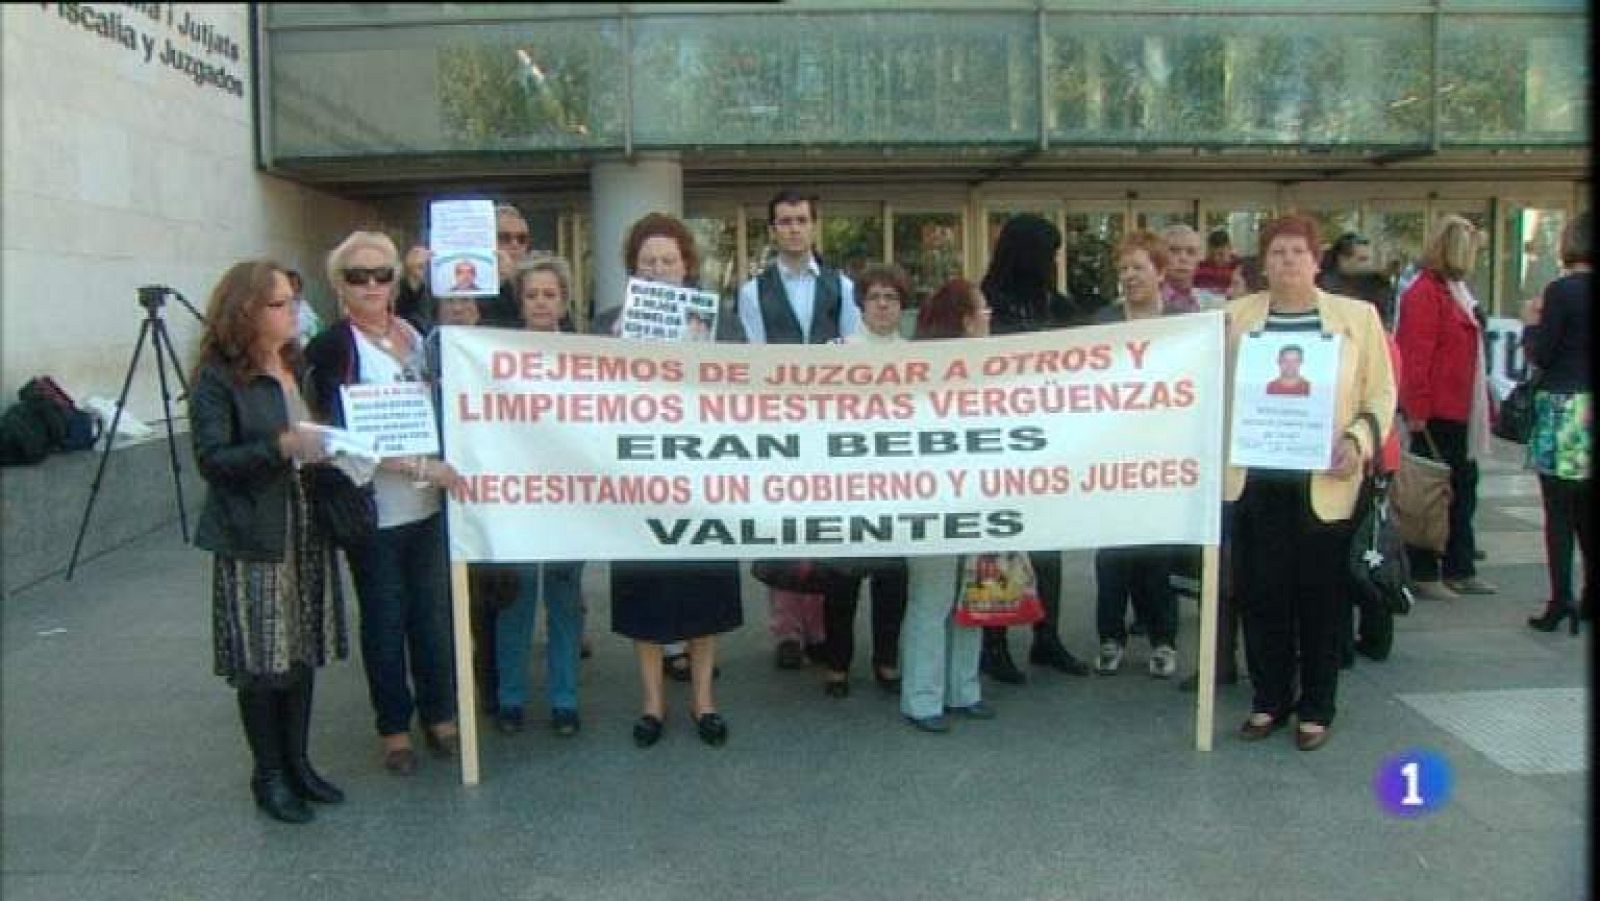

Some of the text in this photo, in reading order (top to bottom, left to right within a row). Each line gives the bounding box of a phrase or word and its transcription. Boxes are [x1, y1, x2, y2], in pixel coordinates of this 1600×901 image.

[178, 11, 239, 62] Jutjats
[141, 33, 155, 64] y
[160, 38, 244, 98] Juzgados
[491, 341, 1150, 386] DEJEMOS DE JUZGAR A OTROS Y
[459, 393, 684, 423] LIMPIEMOS
[700, 391, 914, 422] NUESTRAS
[928, 380, 1195, 417] VERGÜENZAS
[617, 425, 1048, 461] ERAN BEBES
[455, 458, 1199, 504] NECESITAMOS UN GOBIERNO Y UNOS JUECES
[647, 511, 1024, 546] VALIENTES
